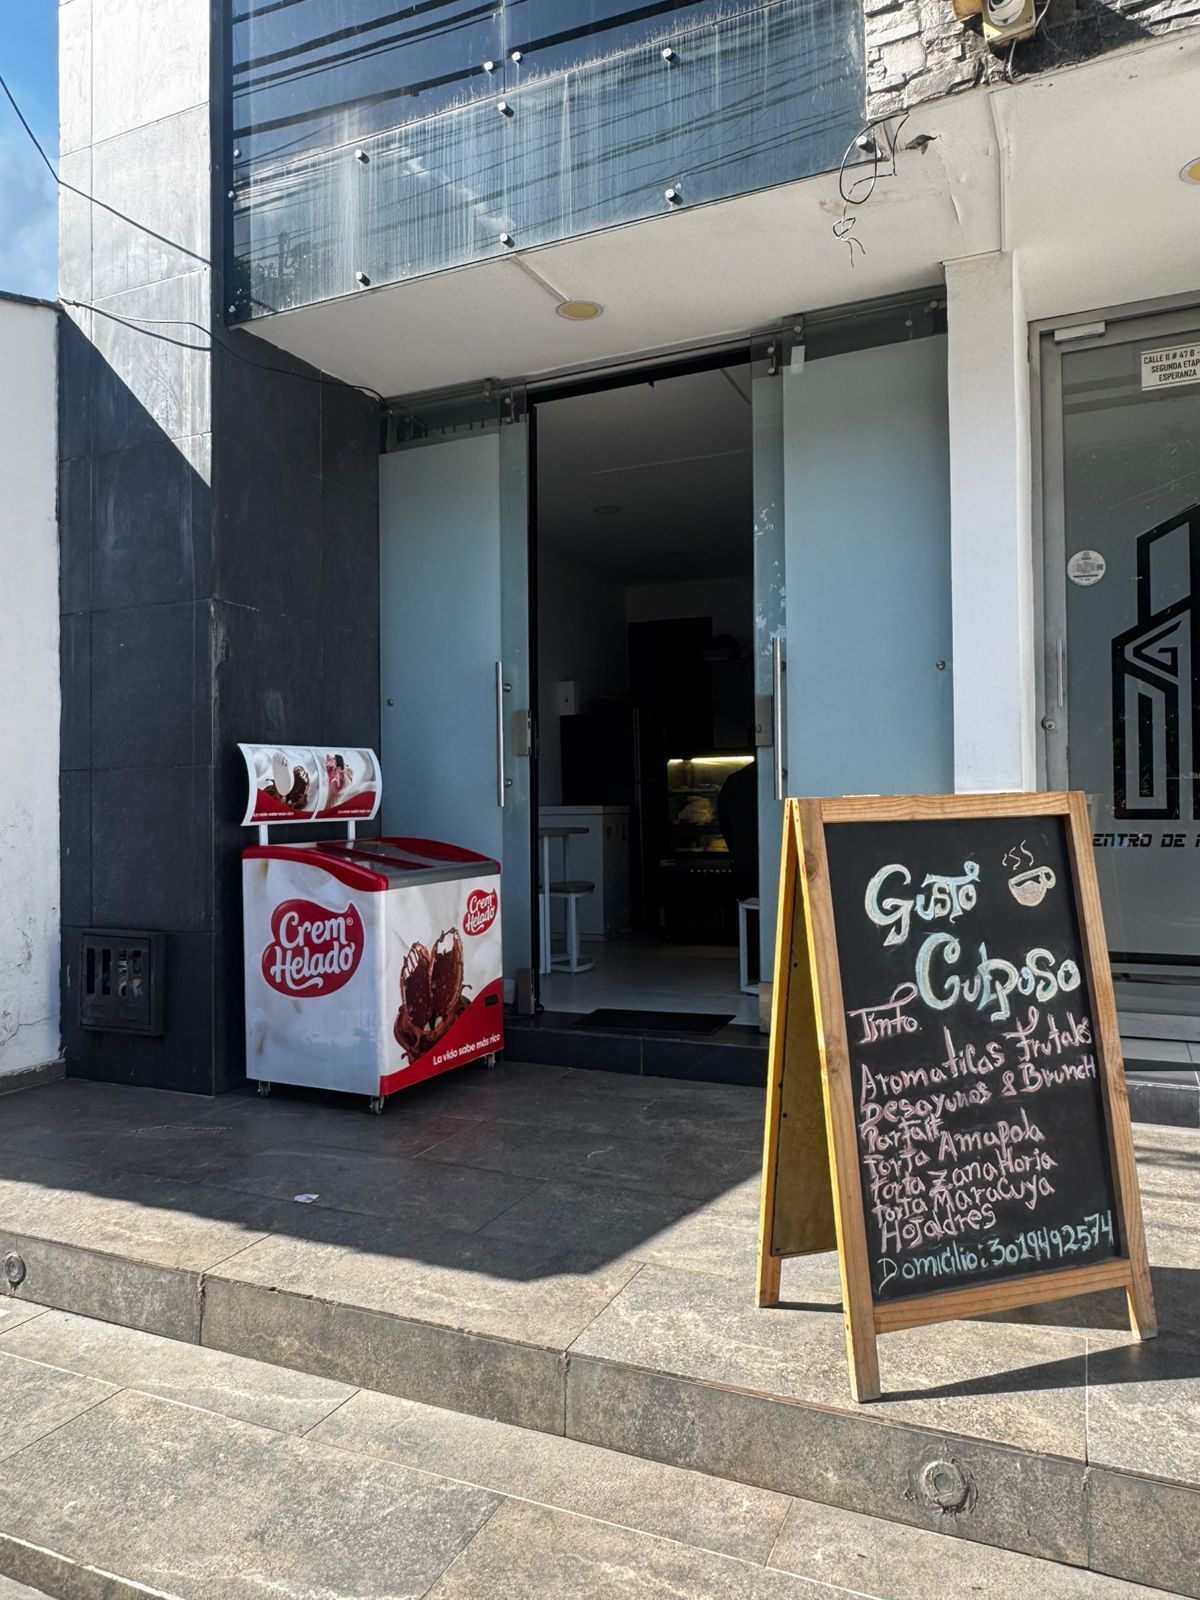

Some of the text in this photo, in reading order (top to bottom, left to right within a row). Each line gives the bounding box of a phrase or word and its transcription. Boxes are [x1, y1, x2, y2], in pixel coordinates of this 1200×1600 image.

[1144, 354, 1163, 364] CALLE
[1179, 350, 1188, 359] 47
[1152, 362, 1182, 373] SEGUNDA
[1159, 369, 1197, 382] ESPERANZA
[1160, 833, 1187, 848] DE
[465, 905, 496, 933] Helado
[469, 894, 494, 914] Crem
[864, 861, 981, 947] Gusto
[279, 911, 349, 949] Crem
[269, 940, 356, 990] Helado
[915, 932, 1082, 1022] Culposo
[433, 1055, 443, 1066] La
[442, 1048, 458, 1062] vida
[458, 1043, 476, 1056] sabe
[489, 1033, 501, 1045] rico
[859, 1081, 993, 1129] Desayunos
[987, 1210, 1115, 1267] 3019492574
